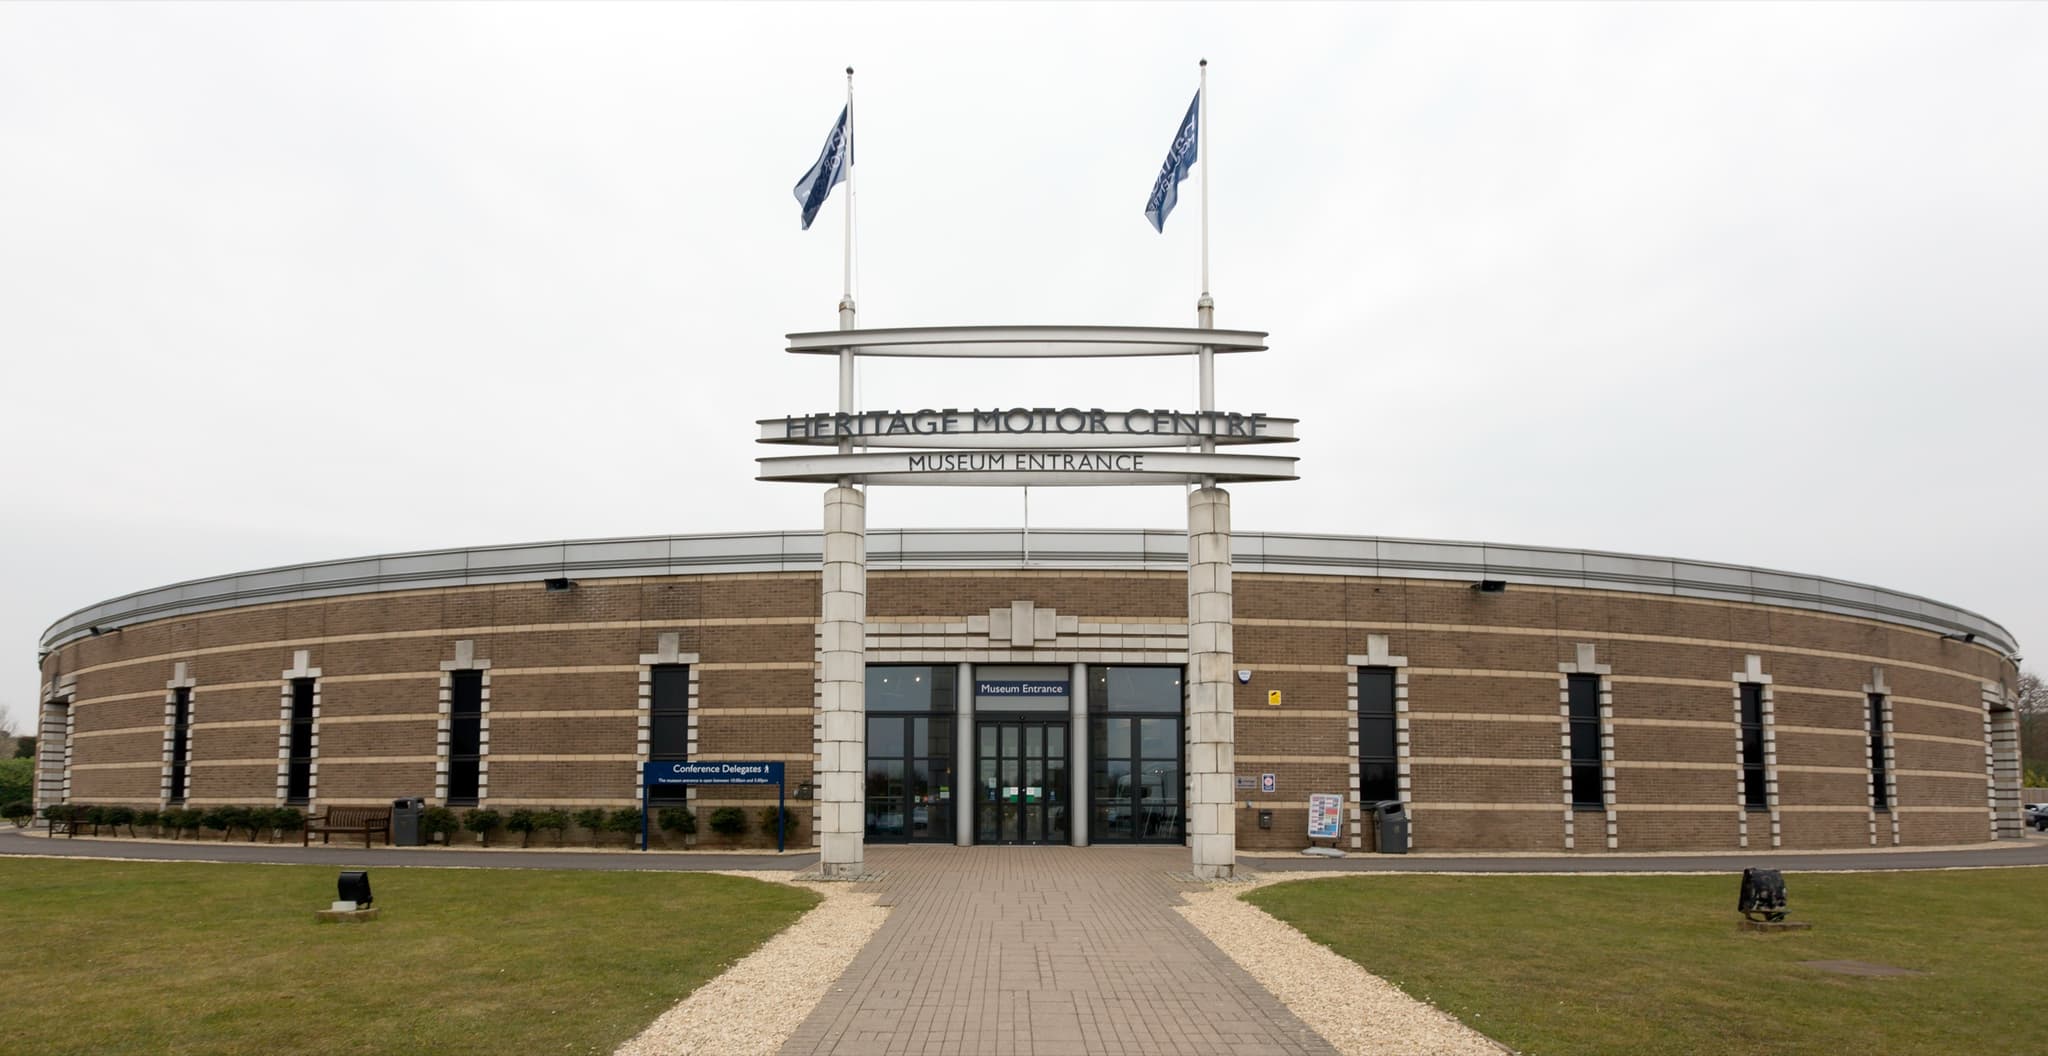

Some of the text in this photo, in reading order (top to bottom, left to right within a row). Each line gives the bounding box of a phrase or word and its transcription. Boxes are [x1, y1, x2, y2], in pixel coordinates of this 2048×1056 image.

[786, 407, 1268, 439] HERITAGE MOTOR CENTRE
[908, 454, 1145, 472] MUSEUM ENTRANCE
[981, 684, 1063, 694] Museum Entrance
[673, 764, 762, 775] Conference Delegates
